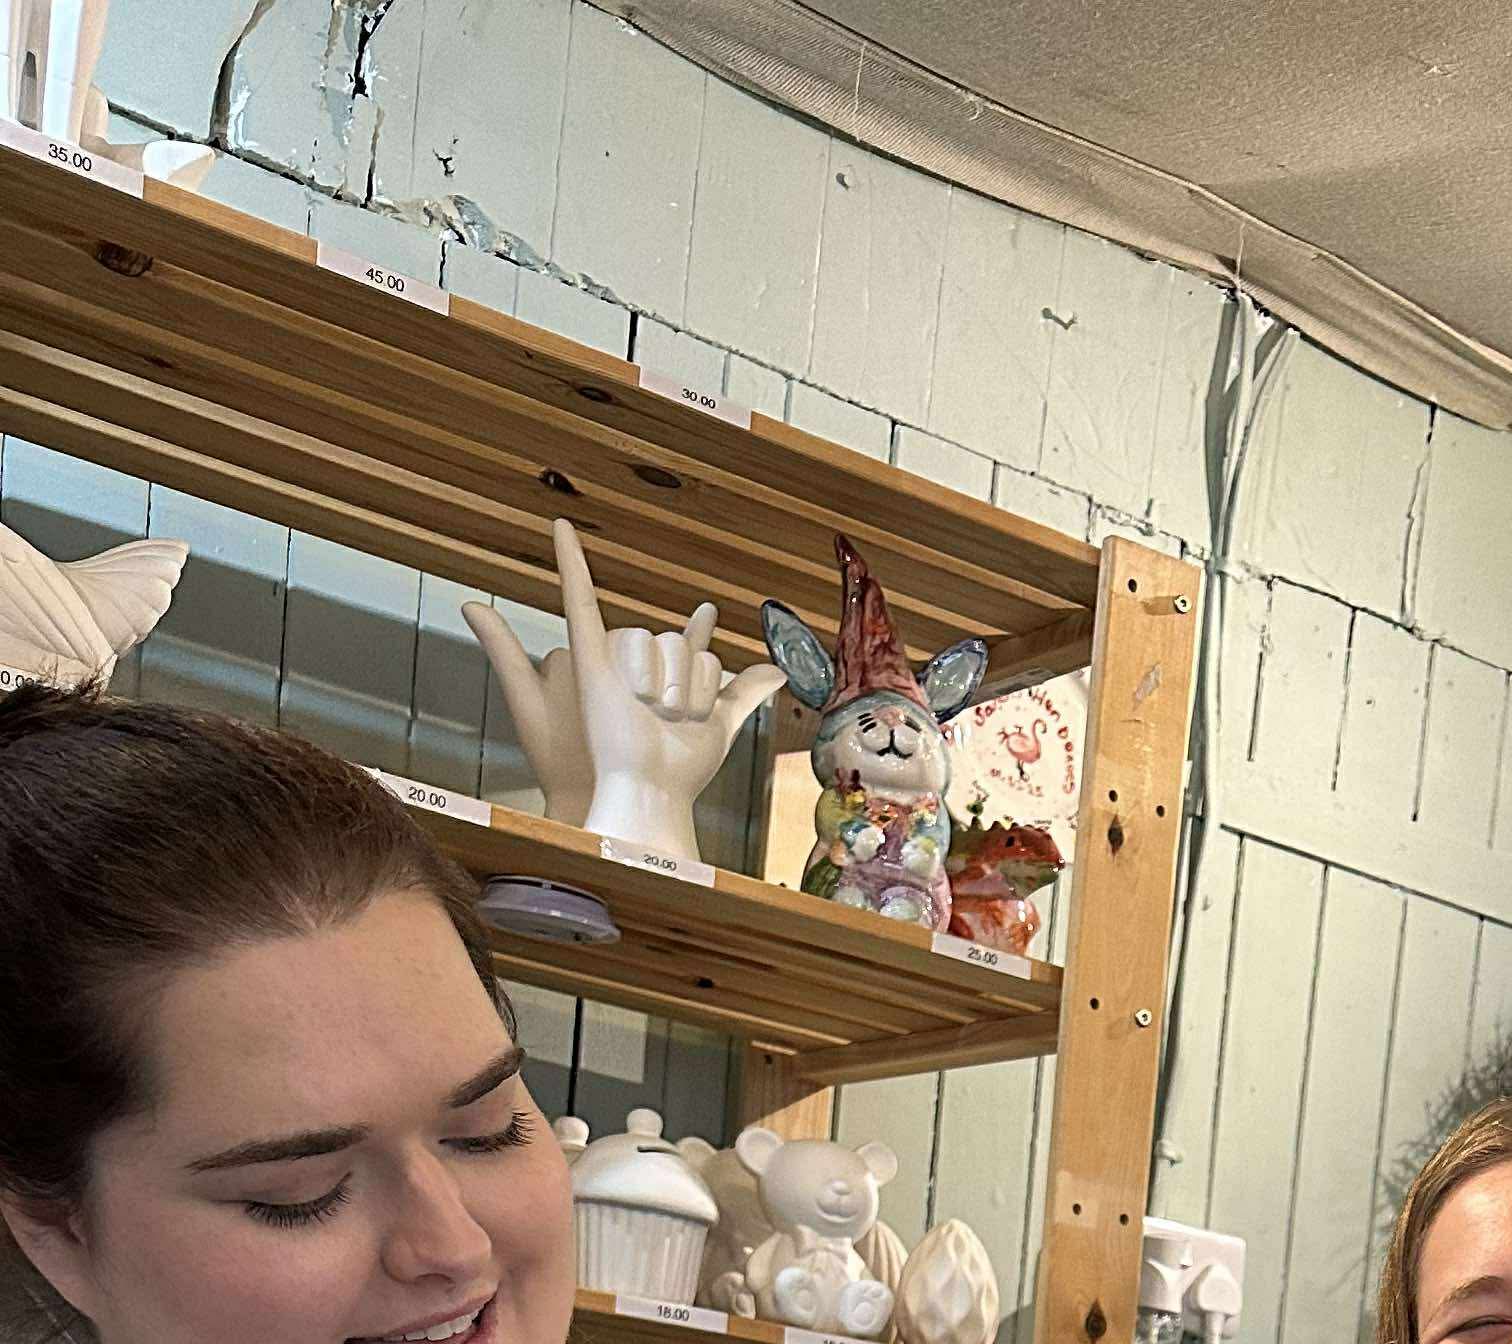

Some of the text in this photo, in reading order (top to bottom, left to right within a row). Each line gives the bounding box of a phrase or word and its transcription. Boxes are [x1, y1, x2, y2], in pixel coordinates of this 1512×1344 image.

[48, 143, 92, 171] 35.00
[365, 267, 405, 292] 45.00
[681, 388, 716, 409] 30.00
[408, 786, 446, 808] 20.00
[643, 853, 677, 871] 20.00
